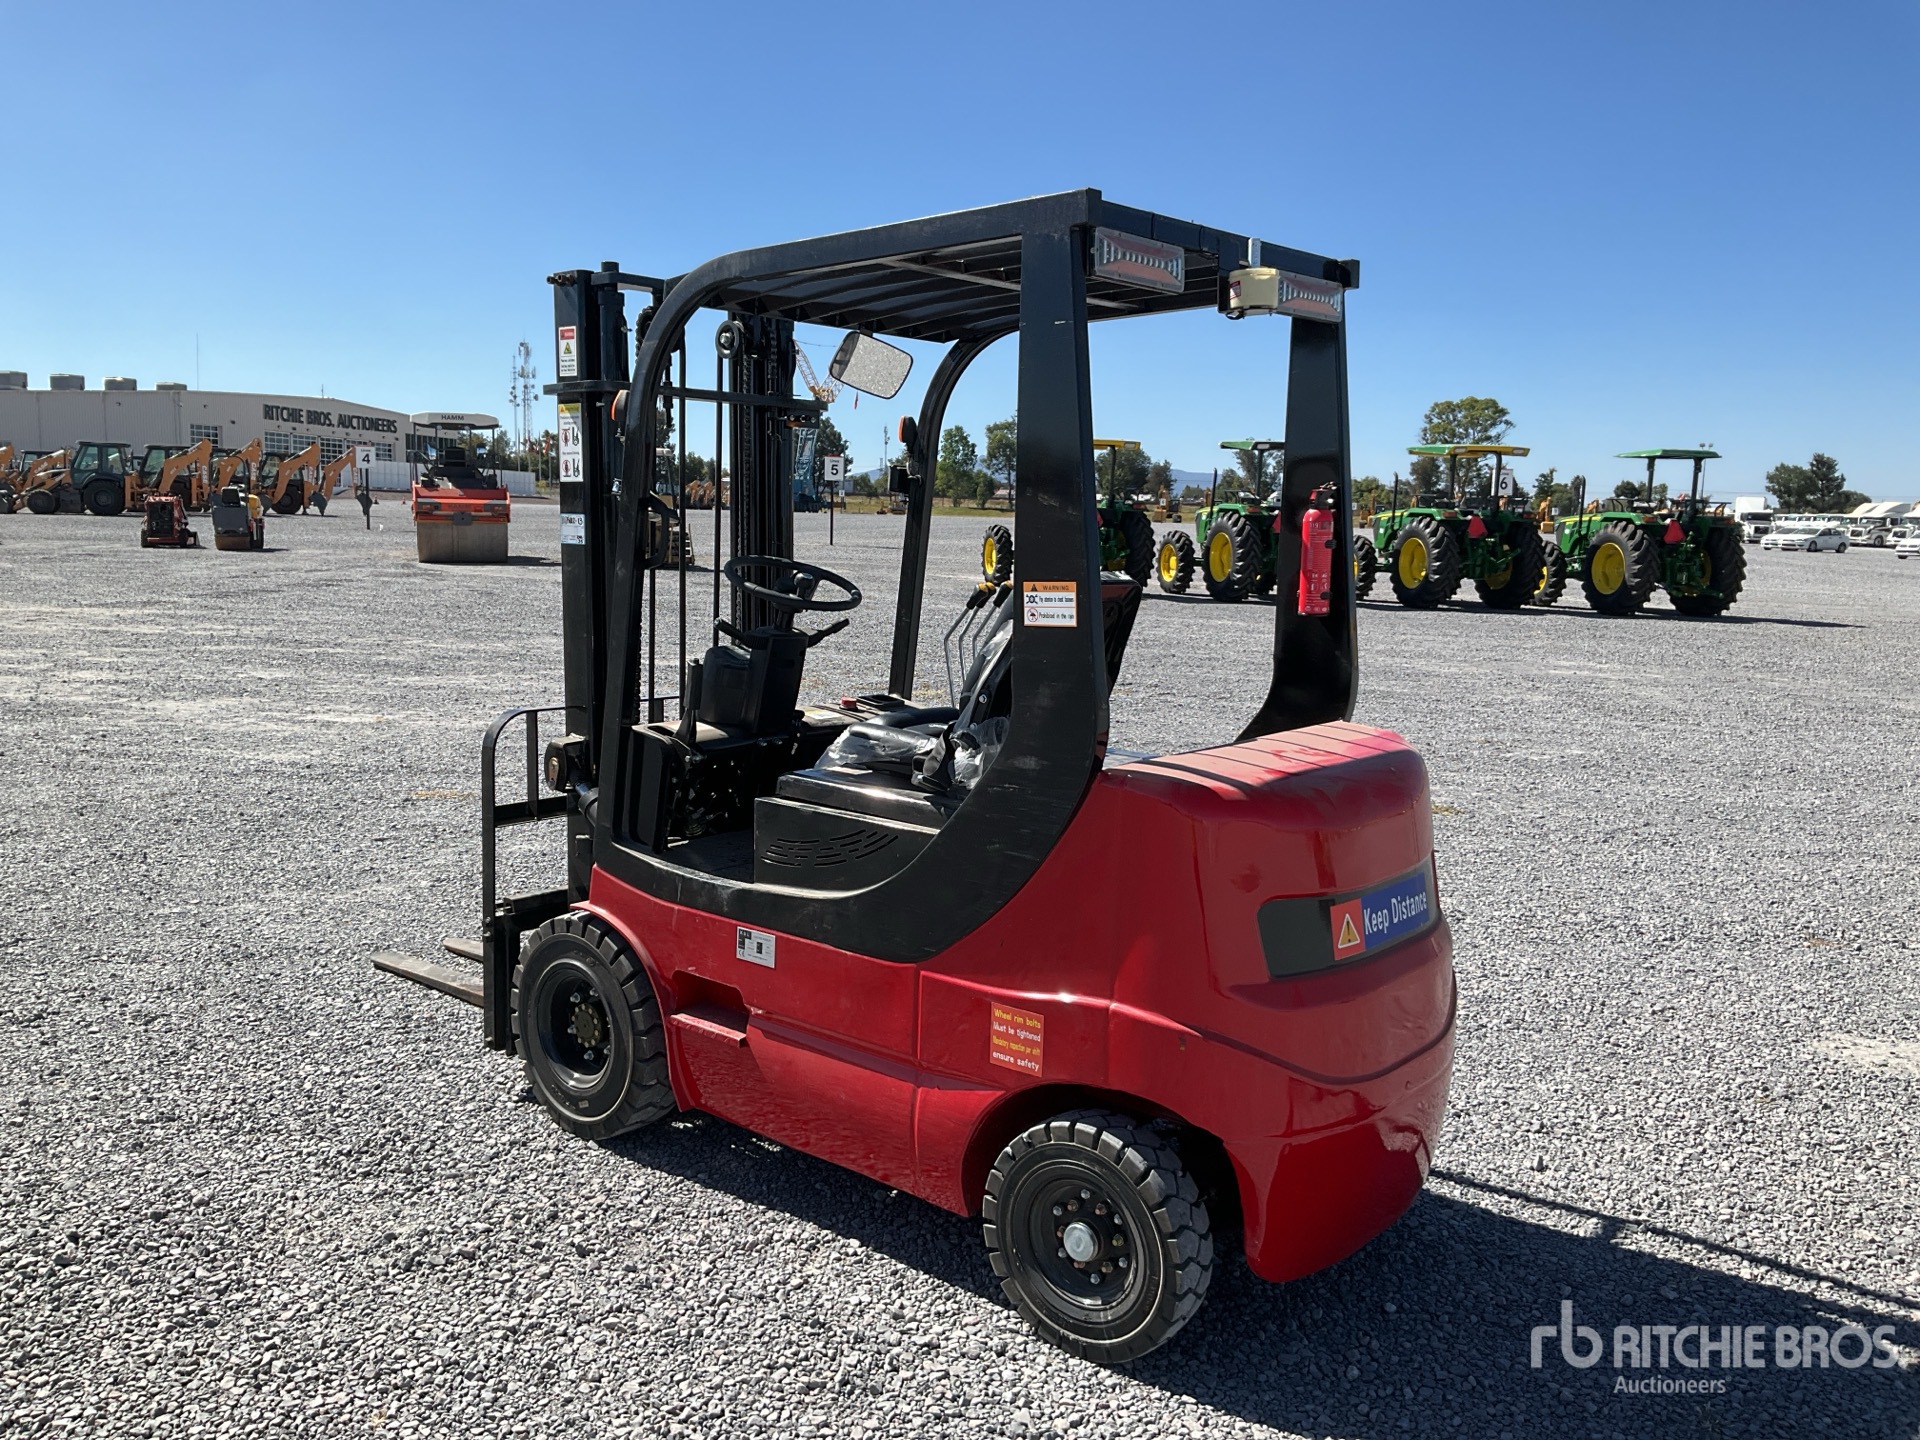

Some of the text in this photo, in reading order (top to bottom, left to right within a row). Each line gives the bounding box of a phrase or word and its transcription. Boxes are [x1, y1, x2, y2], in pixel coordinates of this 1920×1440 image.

[263, 404, 397, 433] RITCHIE BROS. AUCTIONEERS
[362, 453, 370, 464] 4
[201, 465, 209, 484] CASE
[831, 463, 839, 476] 5
[1500, 477, 1508, 490] 6
[1363, 891, 1428, 936] Keep Distance
[993, 1008, 1041, 1029] Wheel rim bolts
[993, 1021, 1041, 1042] Must be tightened
[992, 1051, 1040, 1072] ensure safety
